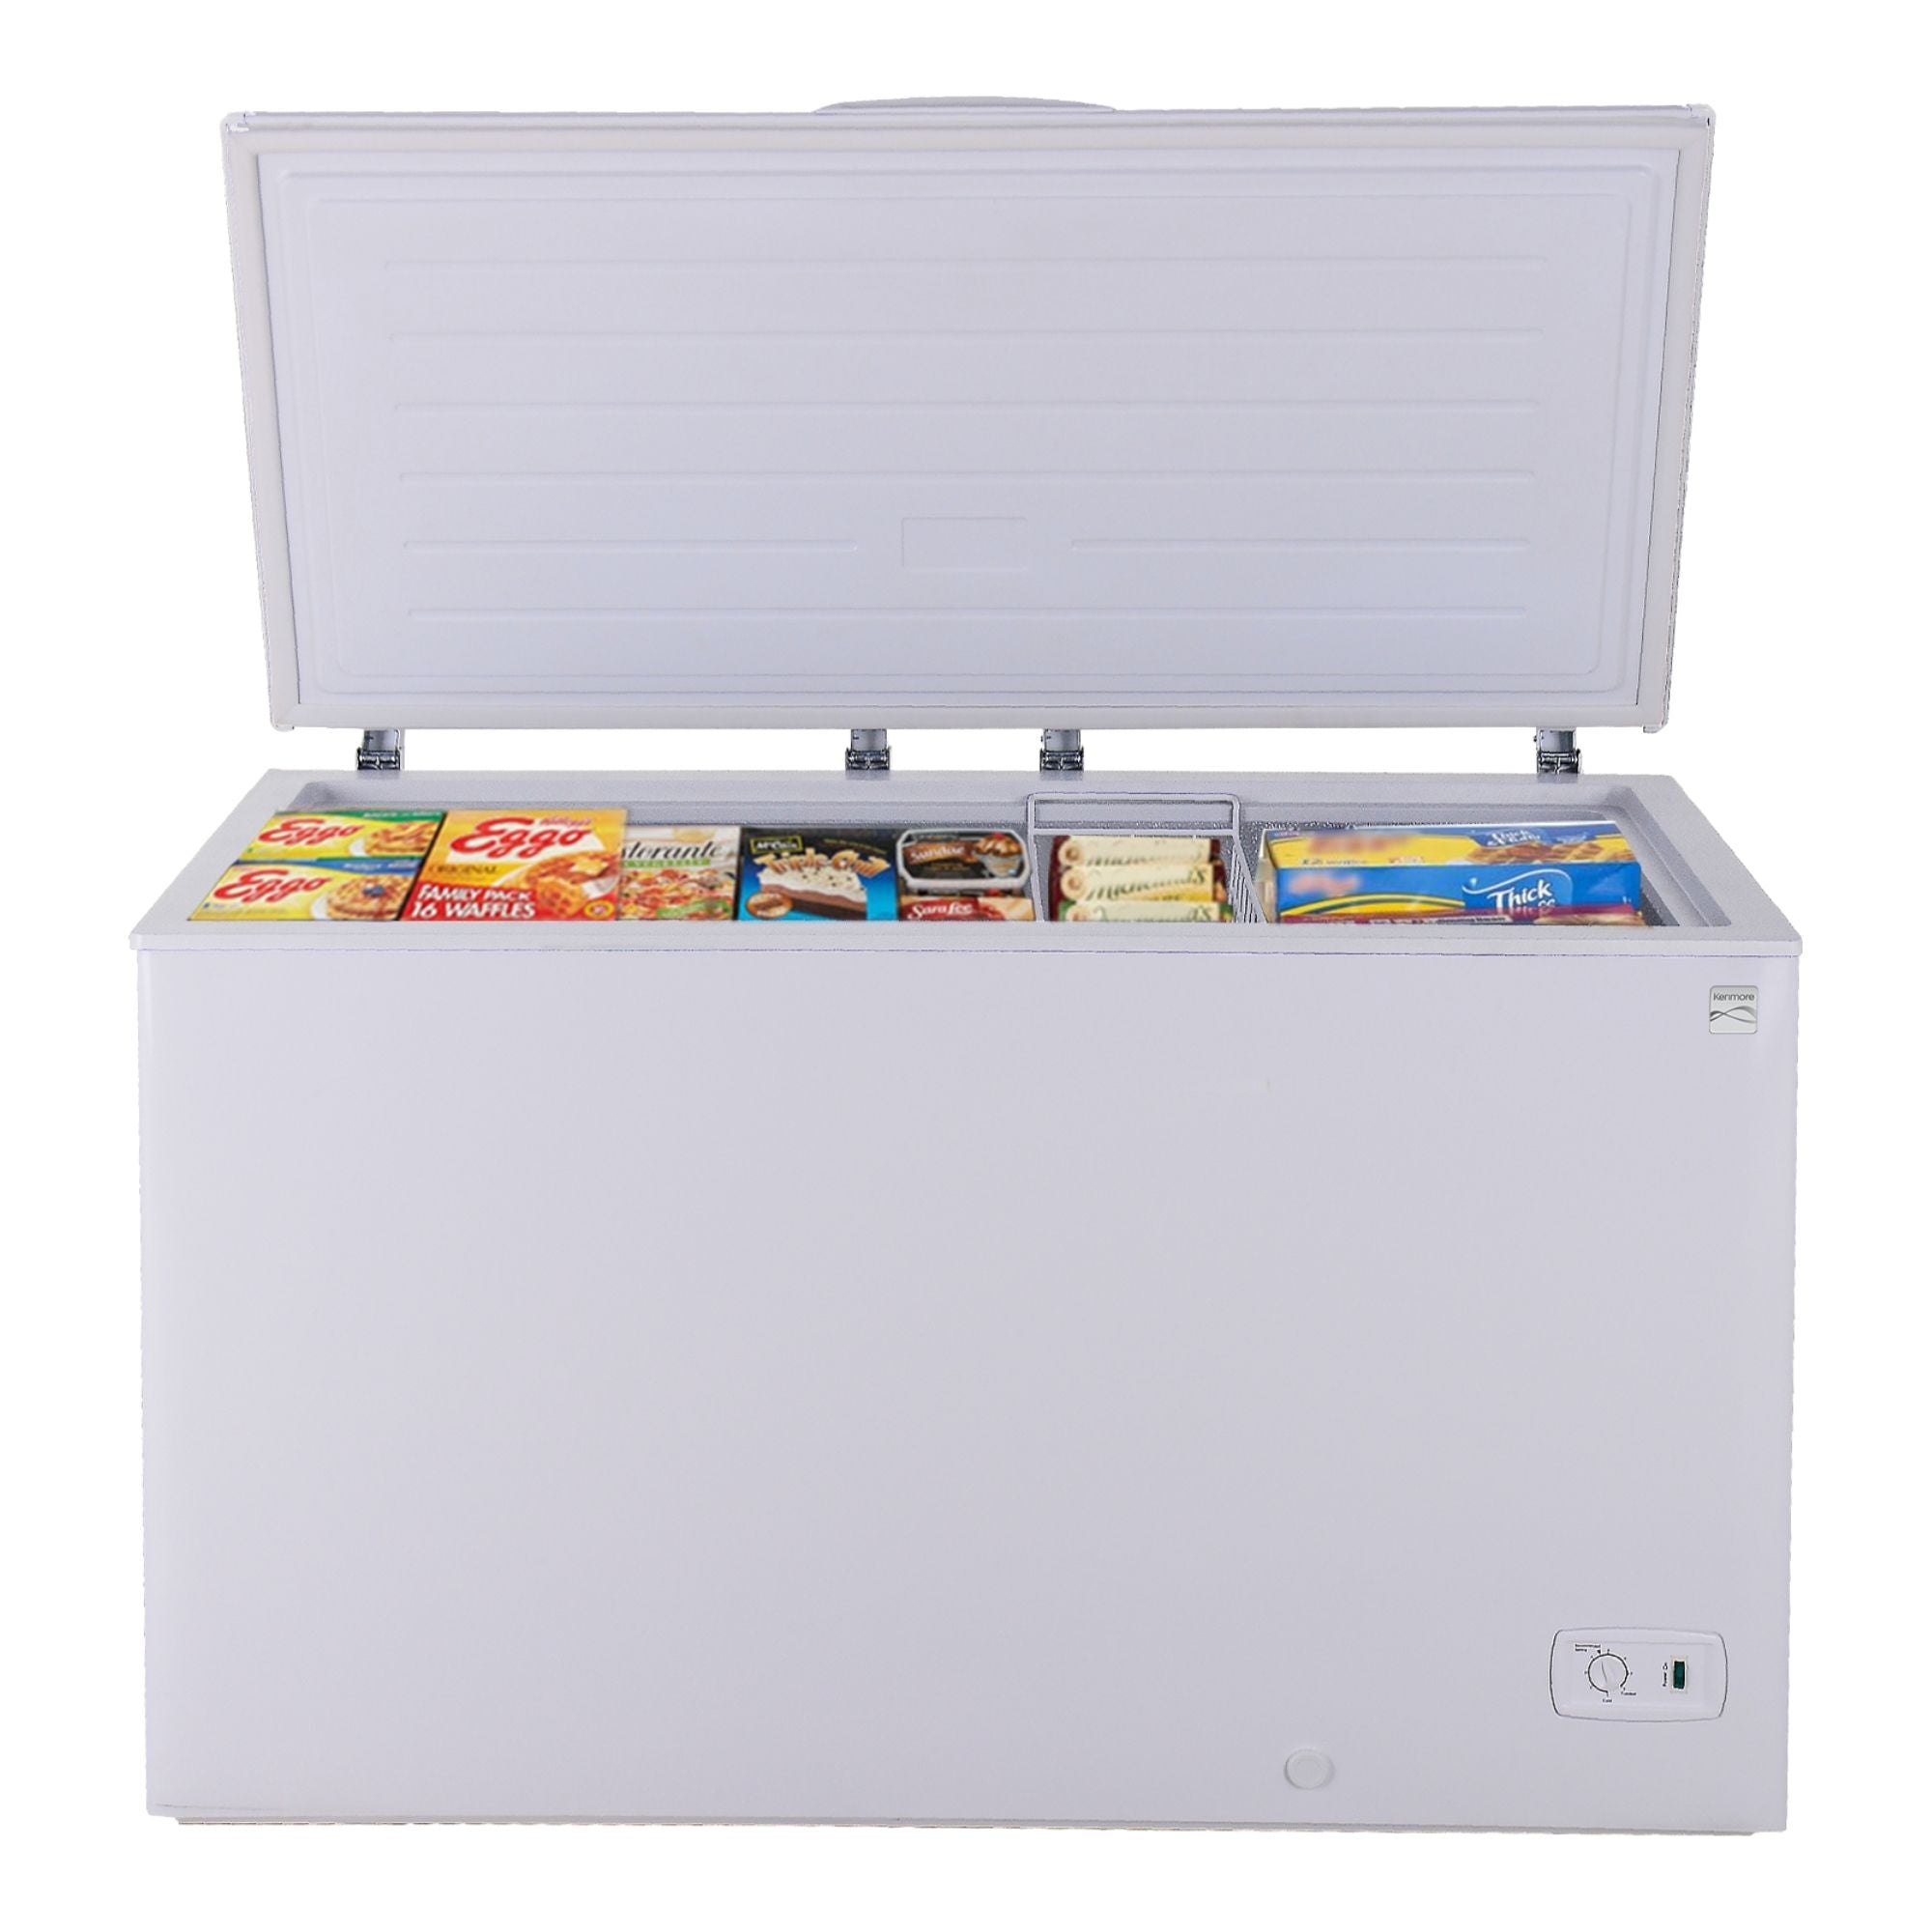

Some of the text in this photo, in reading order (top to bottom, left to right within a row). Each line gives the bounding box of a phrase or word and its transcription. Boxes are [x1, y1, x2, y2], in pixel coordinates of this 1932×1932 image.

[258, 818, 365, 845] Eggo
[450, 817, 592, 858] Eggo
[213, 868, 333, 903] Eggo
[418, 884, 532, 902] FAMILY PACK
[1487, 879, 1552, 915] Thick
[411, 902, 536, 919] 16 WAFFLES
[907, 901, 974, 921] Sara Lee
